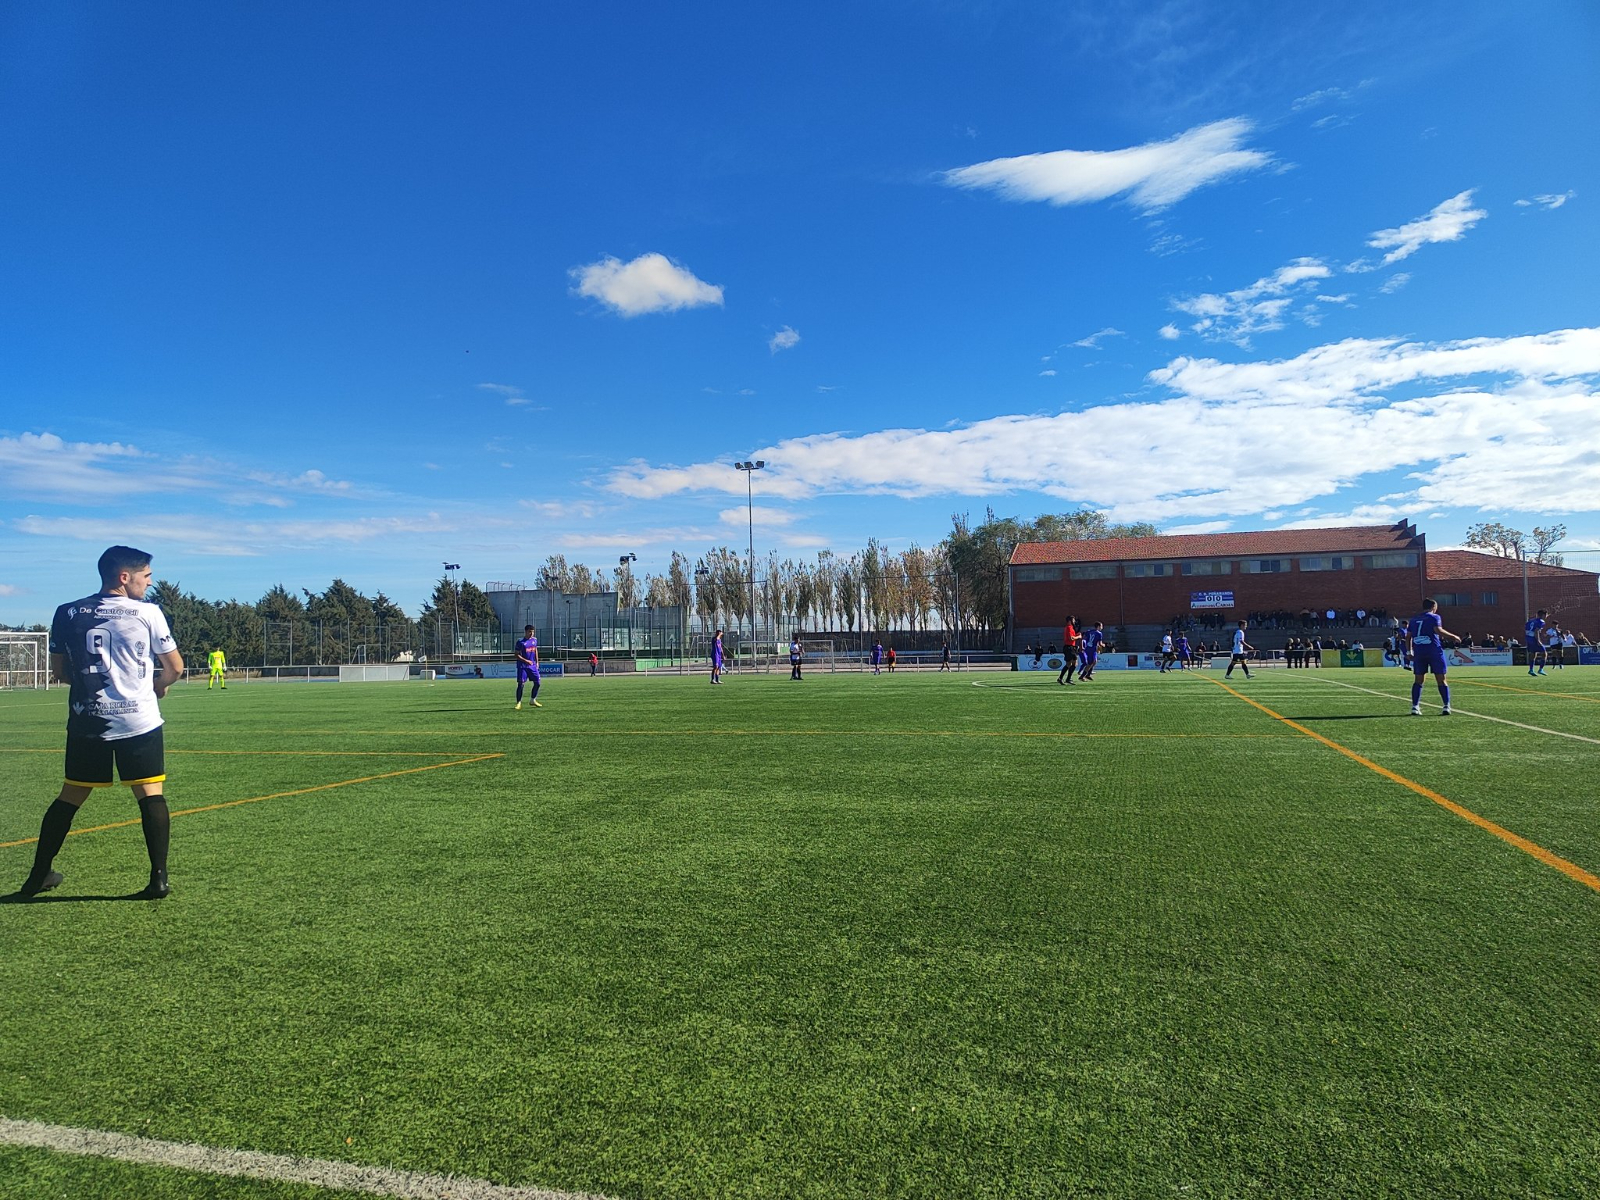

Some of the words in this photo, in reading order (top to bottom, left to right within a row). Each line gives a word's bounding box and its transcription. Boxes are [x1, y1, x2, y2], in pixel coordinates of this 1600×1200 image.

[1416, 620, 1424, 637] 7
[1530, 621, 1535, 631] 9
[85, 628, 112, 674] 9
